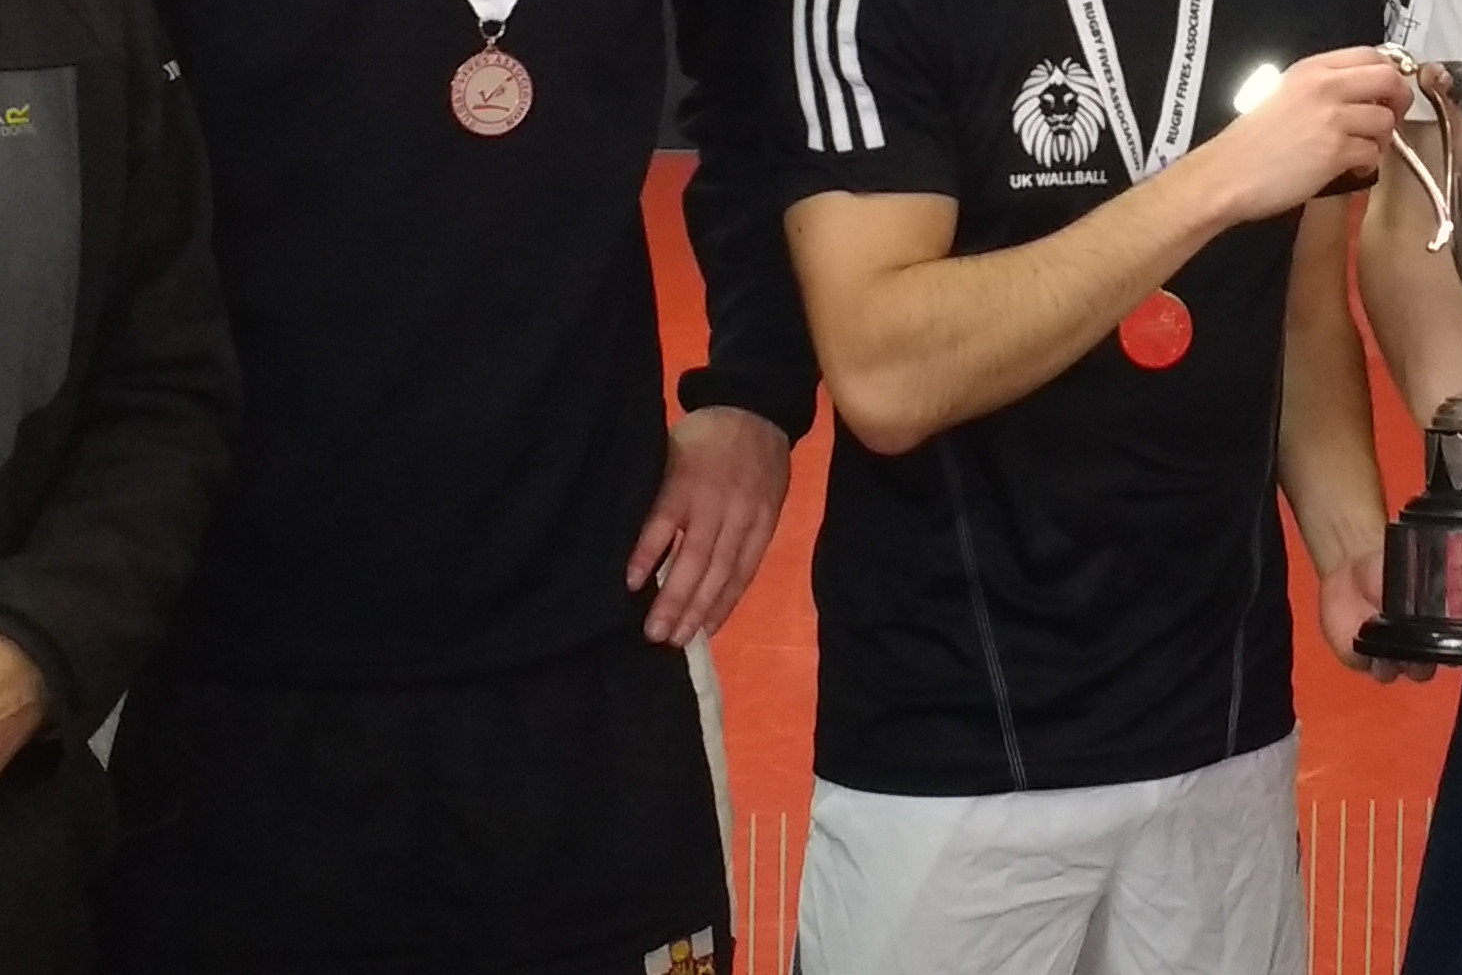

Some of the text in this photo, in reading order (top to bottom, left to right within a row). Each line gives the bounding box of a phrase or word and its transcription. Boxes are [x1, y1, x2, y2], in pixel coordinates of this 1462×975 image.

[1083, 1, 1105, 50] RUGBY
[1097, 47, 1115, 88] FIVES
[1166, 101, 1185, 145] RUGBY
[1176, 62, 1192, 100] FIVES
[1009, 170, 1108, 190] UK WALLBALL
